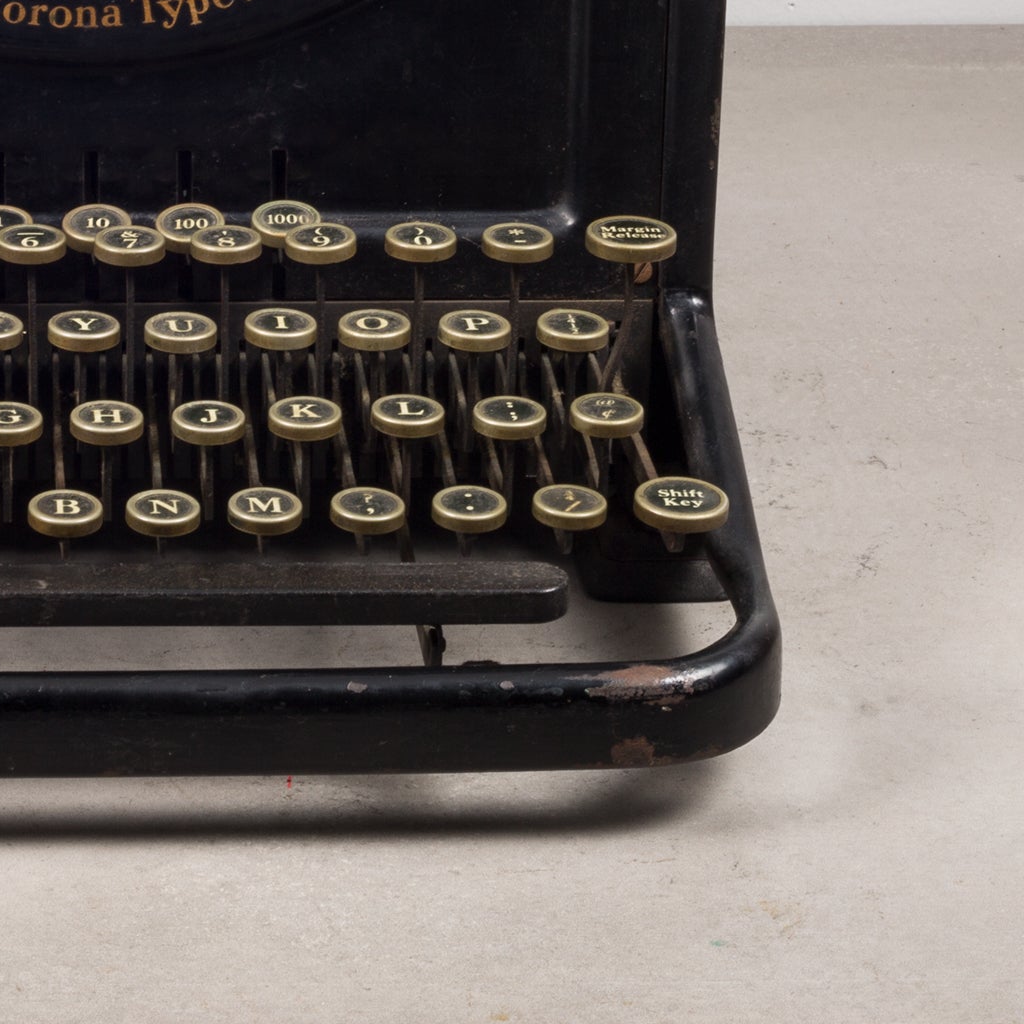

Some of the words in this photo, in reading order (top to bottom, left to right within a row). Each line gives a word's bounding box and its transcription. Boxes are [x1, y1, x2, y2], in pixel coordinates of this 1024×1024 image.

[85, 217, 111, 228] 10
[175, 217, 209, 229] 100
[267, 213, 310, 225] 1000
[120, 230, 139, 238] &
[600, 226, 662, 235] Margin
[601, 232, 666, 240] Release
[20, 236, 39, 248] 6
[123, 238, 137, 249] 7
[217, 236, 235, 247] 8
[313, 236, 331, 247] 9
[70, 317, 98, 331] Y
[164, 319, 194, 333] U
[272, 315, 289, 329] I
[355, 316, 389, 330] O
[461, 317, 490, 331] P
[289, 403, 322, 418] K
[396, 401, 424, 416] L
[91, 408, 124, 424] H
[200, 408, 220, 423] J
[657, 488, 705, 499] Shift
[53, 499, 81, 515] B
[148, 499, 179, 514] N
[247, 497, 283, 513] M
[663, 497, 704, 509] Key
